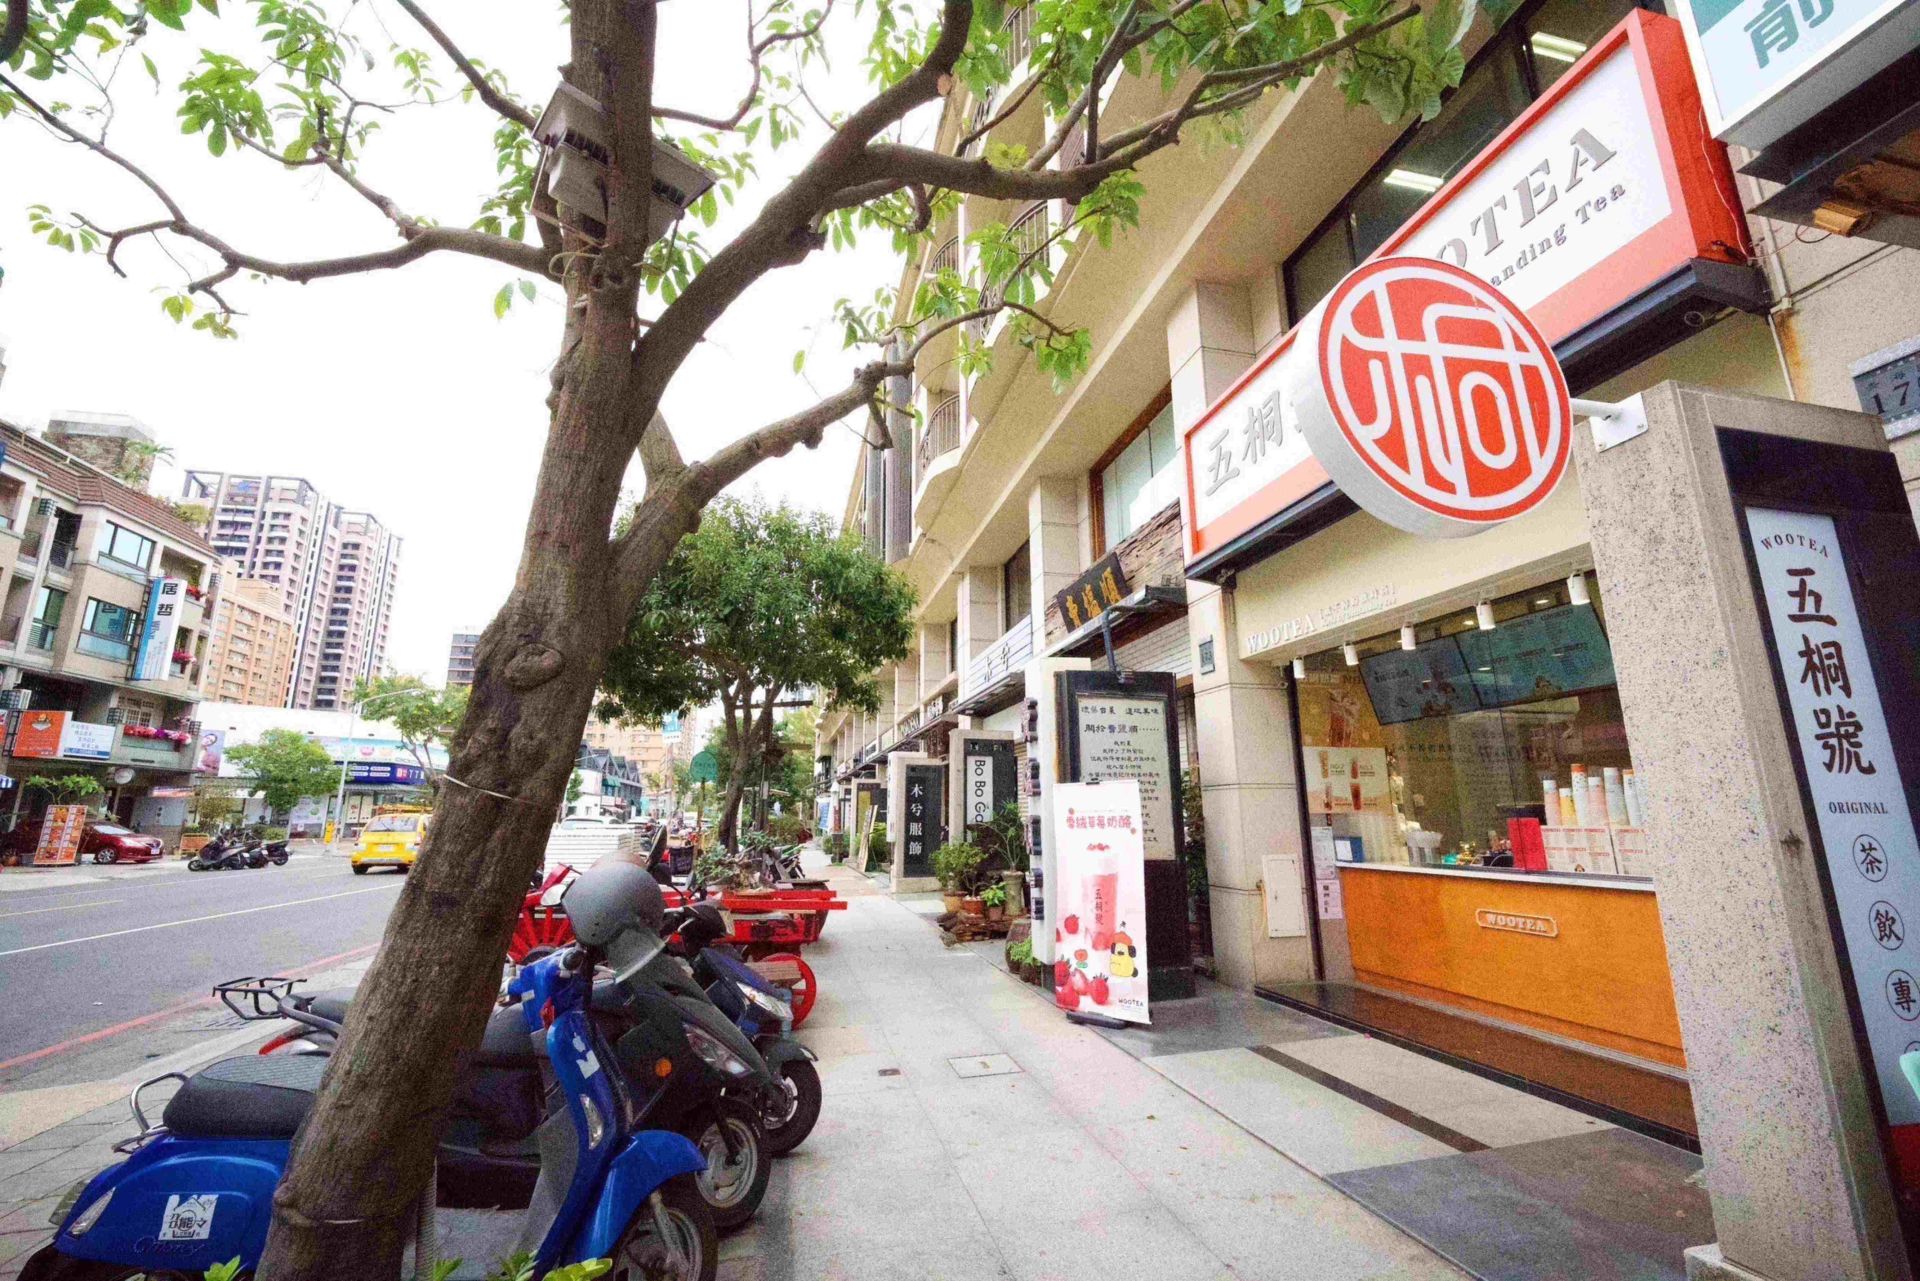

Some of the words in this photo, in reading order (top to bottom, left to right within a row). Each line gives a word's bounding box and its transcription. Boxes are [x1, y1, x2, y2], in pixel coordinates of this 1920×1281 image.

[1490, 223, 1567, 287] anding
[1575, 183, 1626, 224] Tea
[1205, 390, 1301, 497] 五桐
[1760, 533, 1830, 558] WOOTEA
[1246, 612, 1317, 654] WOOTEA
[1786, 567, 1876, 775] 五桐號
[974, 759, 986, 776] Bo
[974, 780, 986, 798] Bo
[1828, 801, 1889, 815] ORIGINAL
[1486, 912, 1547, 933] WOOTEA
[1118, 998, 1144, 1008] WOOTEA
